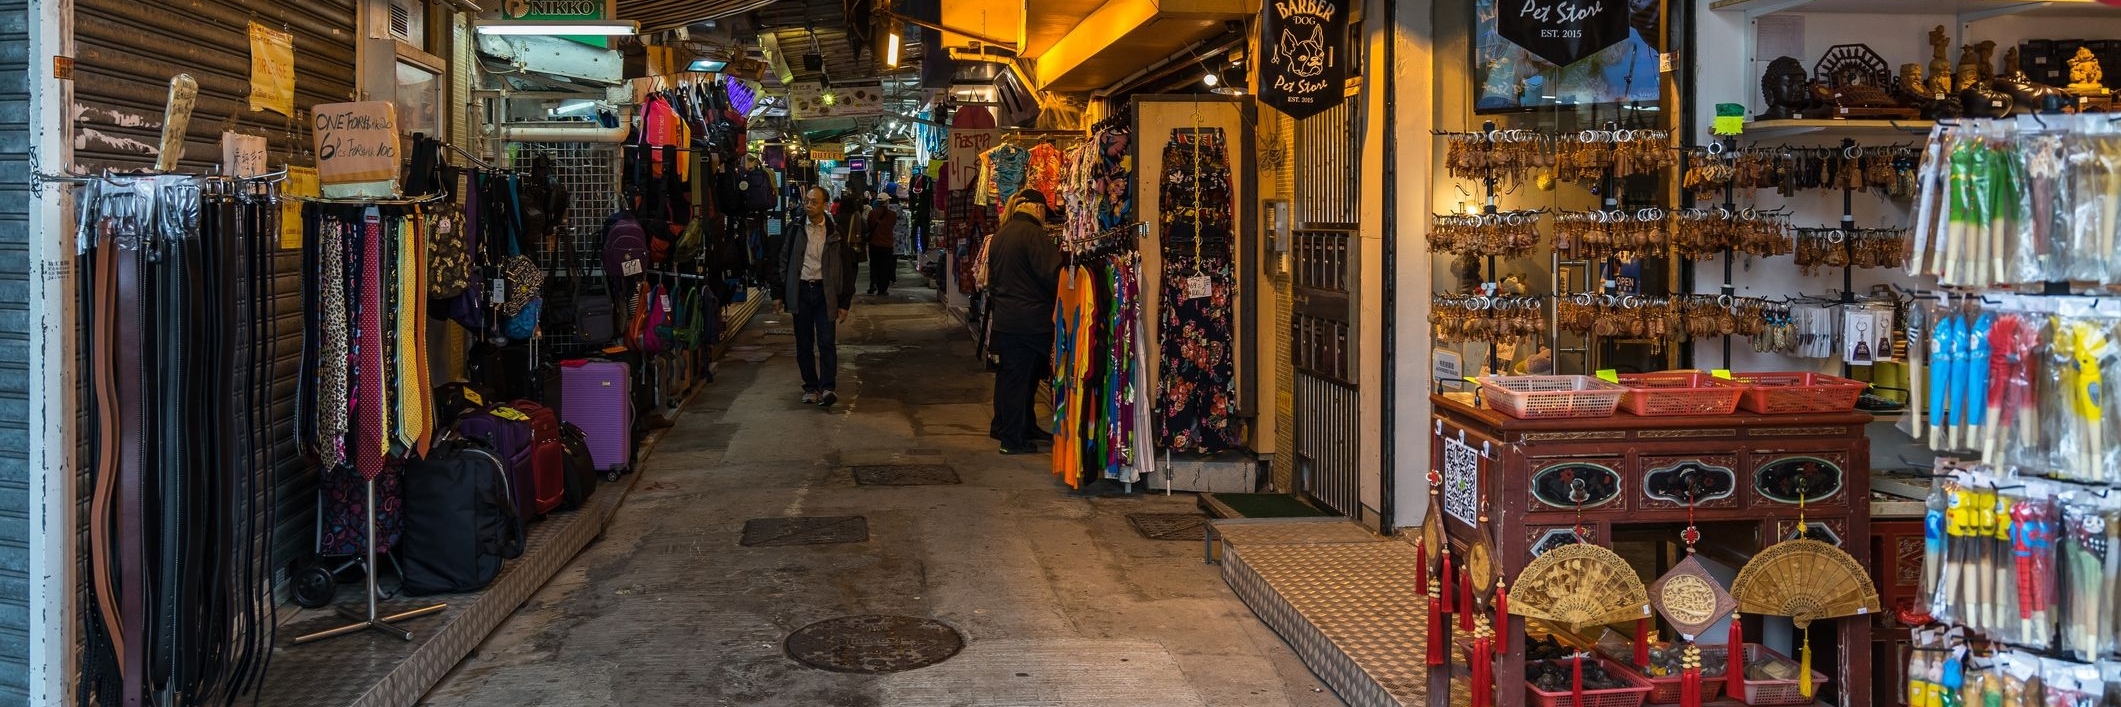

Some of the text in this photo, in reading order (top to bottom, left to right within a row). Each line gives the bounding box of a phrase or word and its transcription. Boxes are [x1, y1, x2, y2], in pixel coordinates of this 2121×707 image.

[531, 0, 595, 15] NIKKO
[1275, 0, 1336, 22] BARBER
[1519, 0, 1603, 24] Pet Store
[1292, 15, 1316, 25] DOG
[1540, 29, 1582, 38] EST. 2015
[1274, 75, 1328, 94] Pet Store
[316, 113, 344, 131] ONE
[812, 152, 842, 160] OUTLET
[624, 260, 638, 274] 99
[1616, 276, 1634, 287] OPEN
